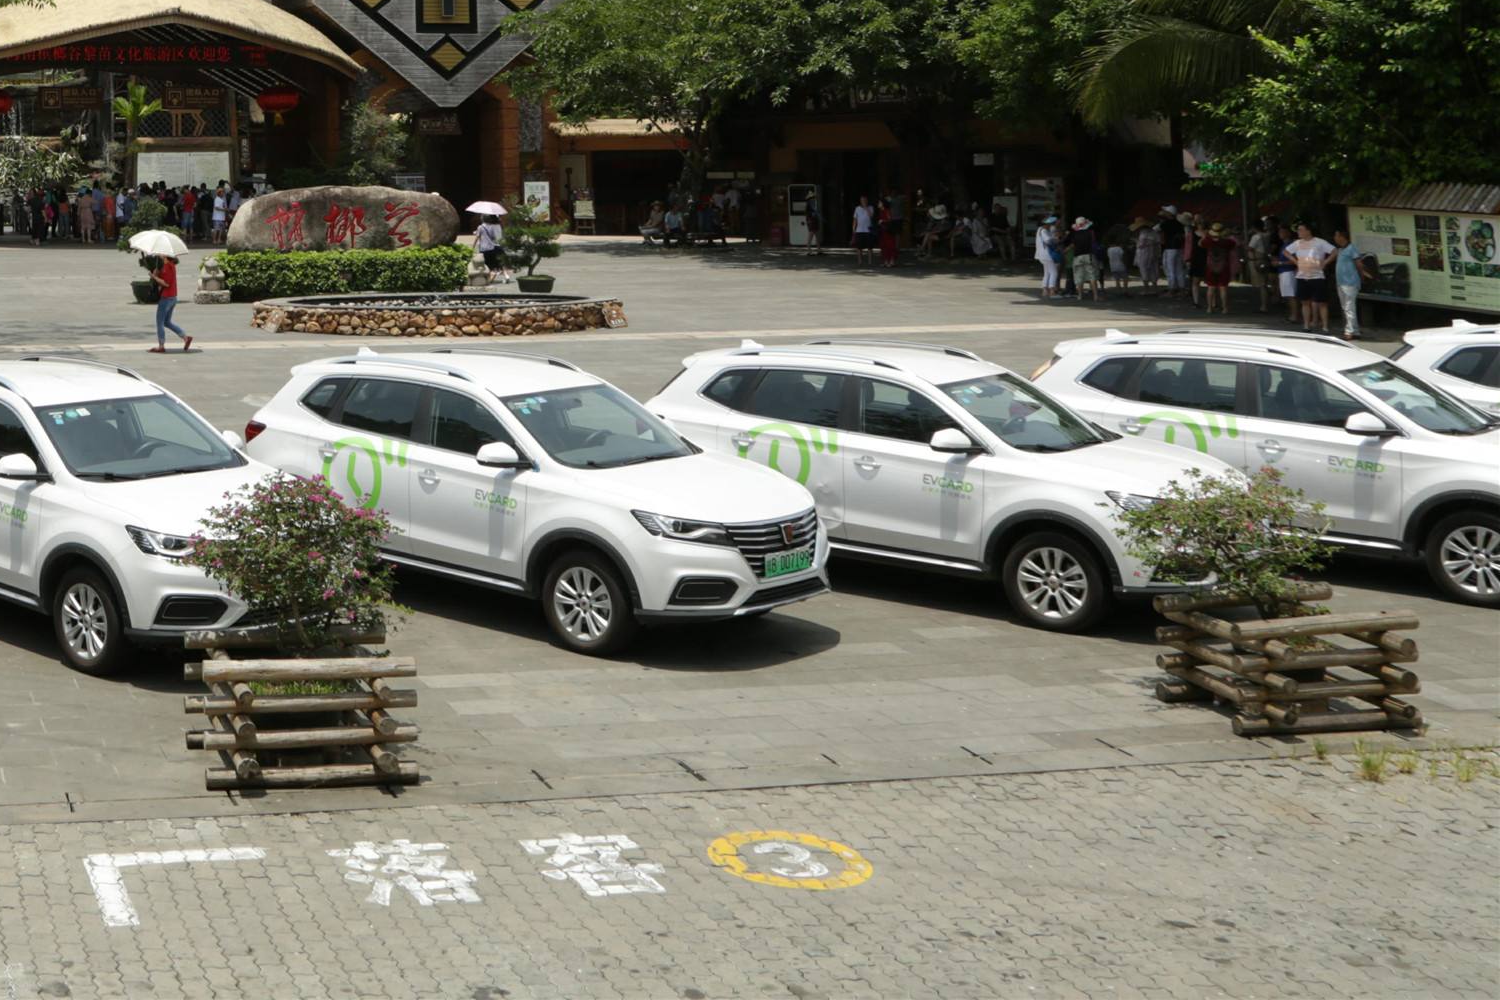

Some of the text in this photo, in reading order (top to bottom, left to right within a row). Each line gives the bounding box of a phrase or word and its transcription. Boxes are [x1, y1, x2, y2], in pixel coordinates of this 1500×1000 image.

[1328, 455, 1385, 473] EVCARD
[923, 473, 974, 493] EVCARD
[475, 489, 517, 509] EVCARD
